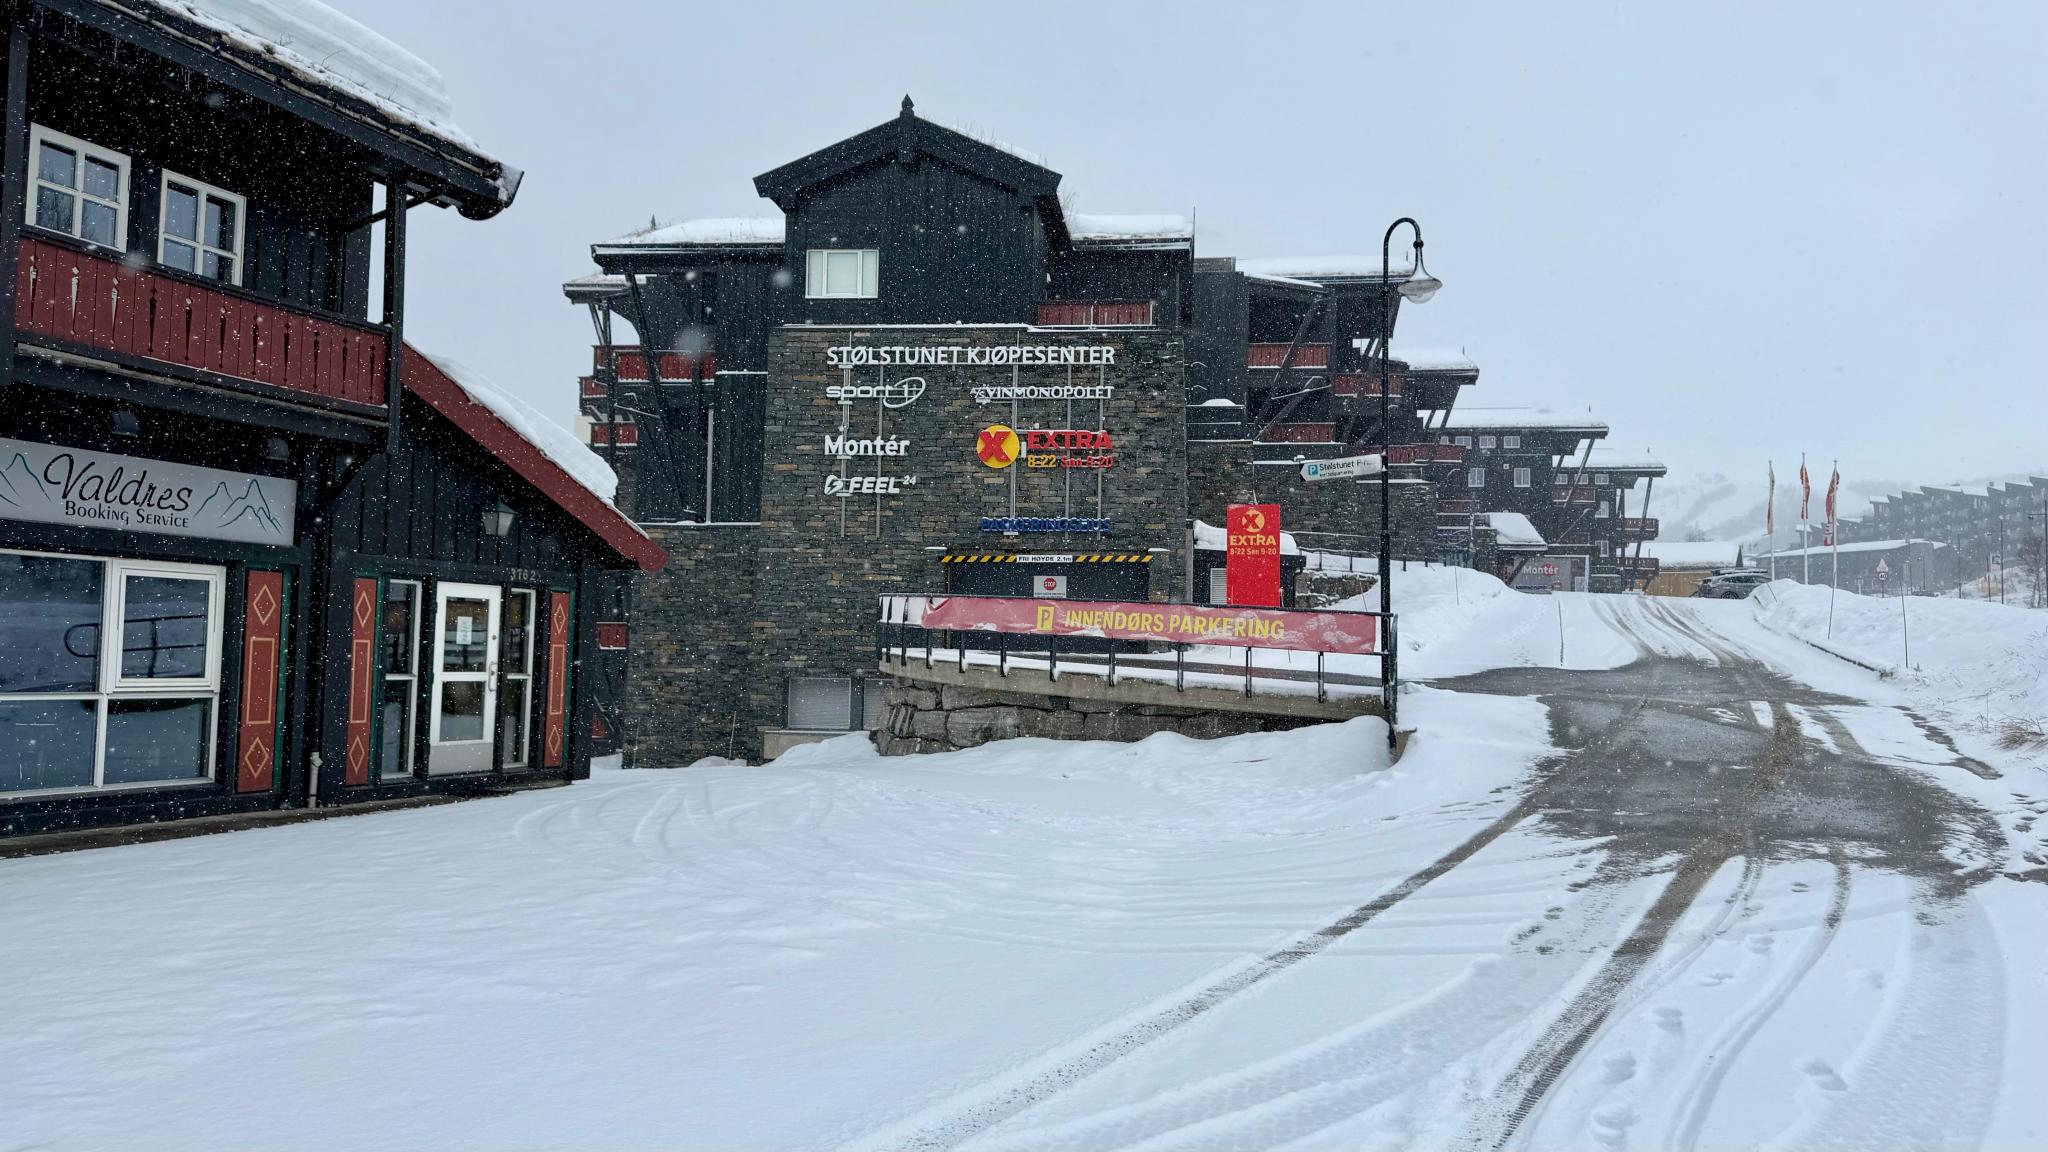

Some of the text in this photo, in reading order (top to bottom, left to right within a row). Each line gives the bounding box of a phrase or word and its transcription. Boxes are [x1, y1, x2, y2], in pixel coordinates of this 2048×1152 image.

[827, 346, 1115, 365] STØLSTUNET KJØPESENTER
[986, 386, 1114, 399] VINMONOPOLET
[824, 434, 910, 456] Montér
[1027, 430, 1113, 449] EXTRA
[1027, 454, 1057, 468] 8-22
[43, 453, 193, 512] Valdres
[848, 476, 900, 494] FEEL
[1230, 534, 1277, 546] EXTRA
[1065, 610, 1164, 632] INNENDØRS
[1169, 615, 1285, 638] PARKERING
